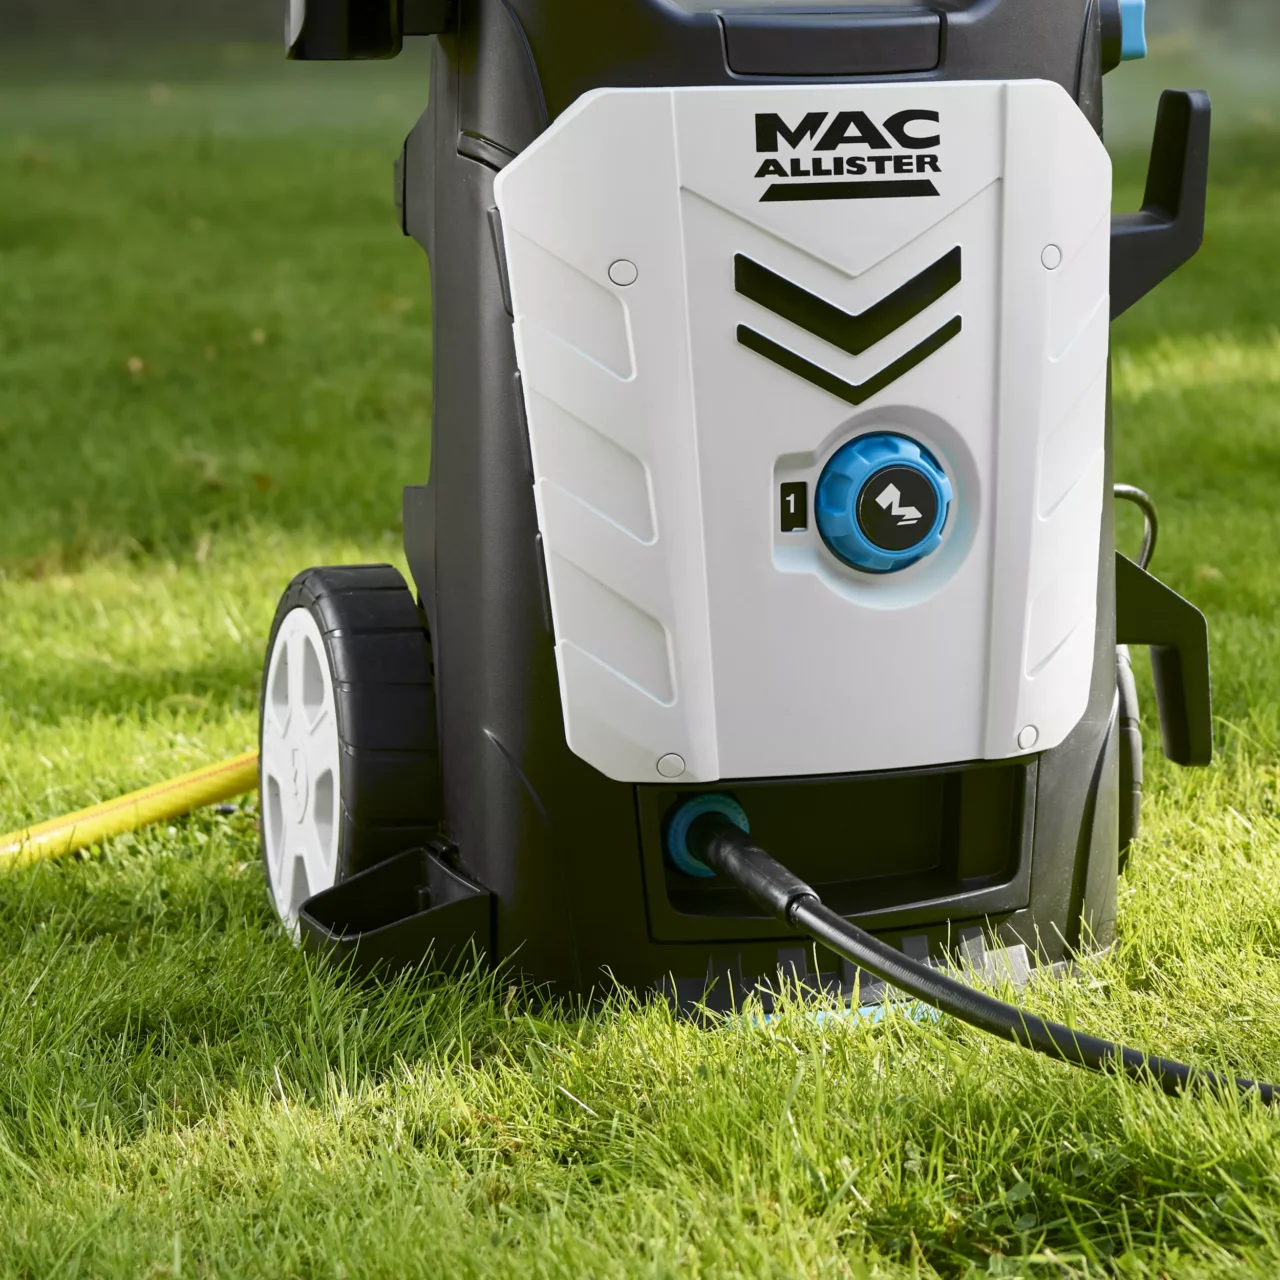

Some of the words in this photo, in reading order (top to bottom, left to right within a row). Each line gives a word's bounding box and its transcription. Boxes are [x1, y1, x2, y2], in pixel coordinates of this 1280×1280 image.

[755, 109, 940, 152] MAC
[754, 154, 942, 178] ALLISTER
[785, 493, 795, 514] 1
